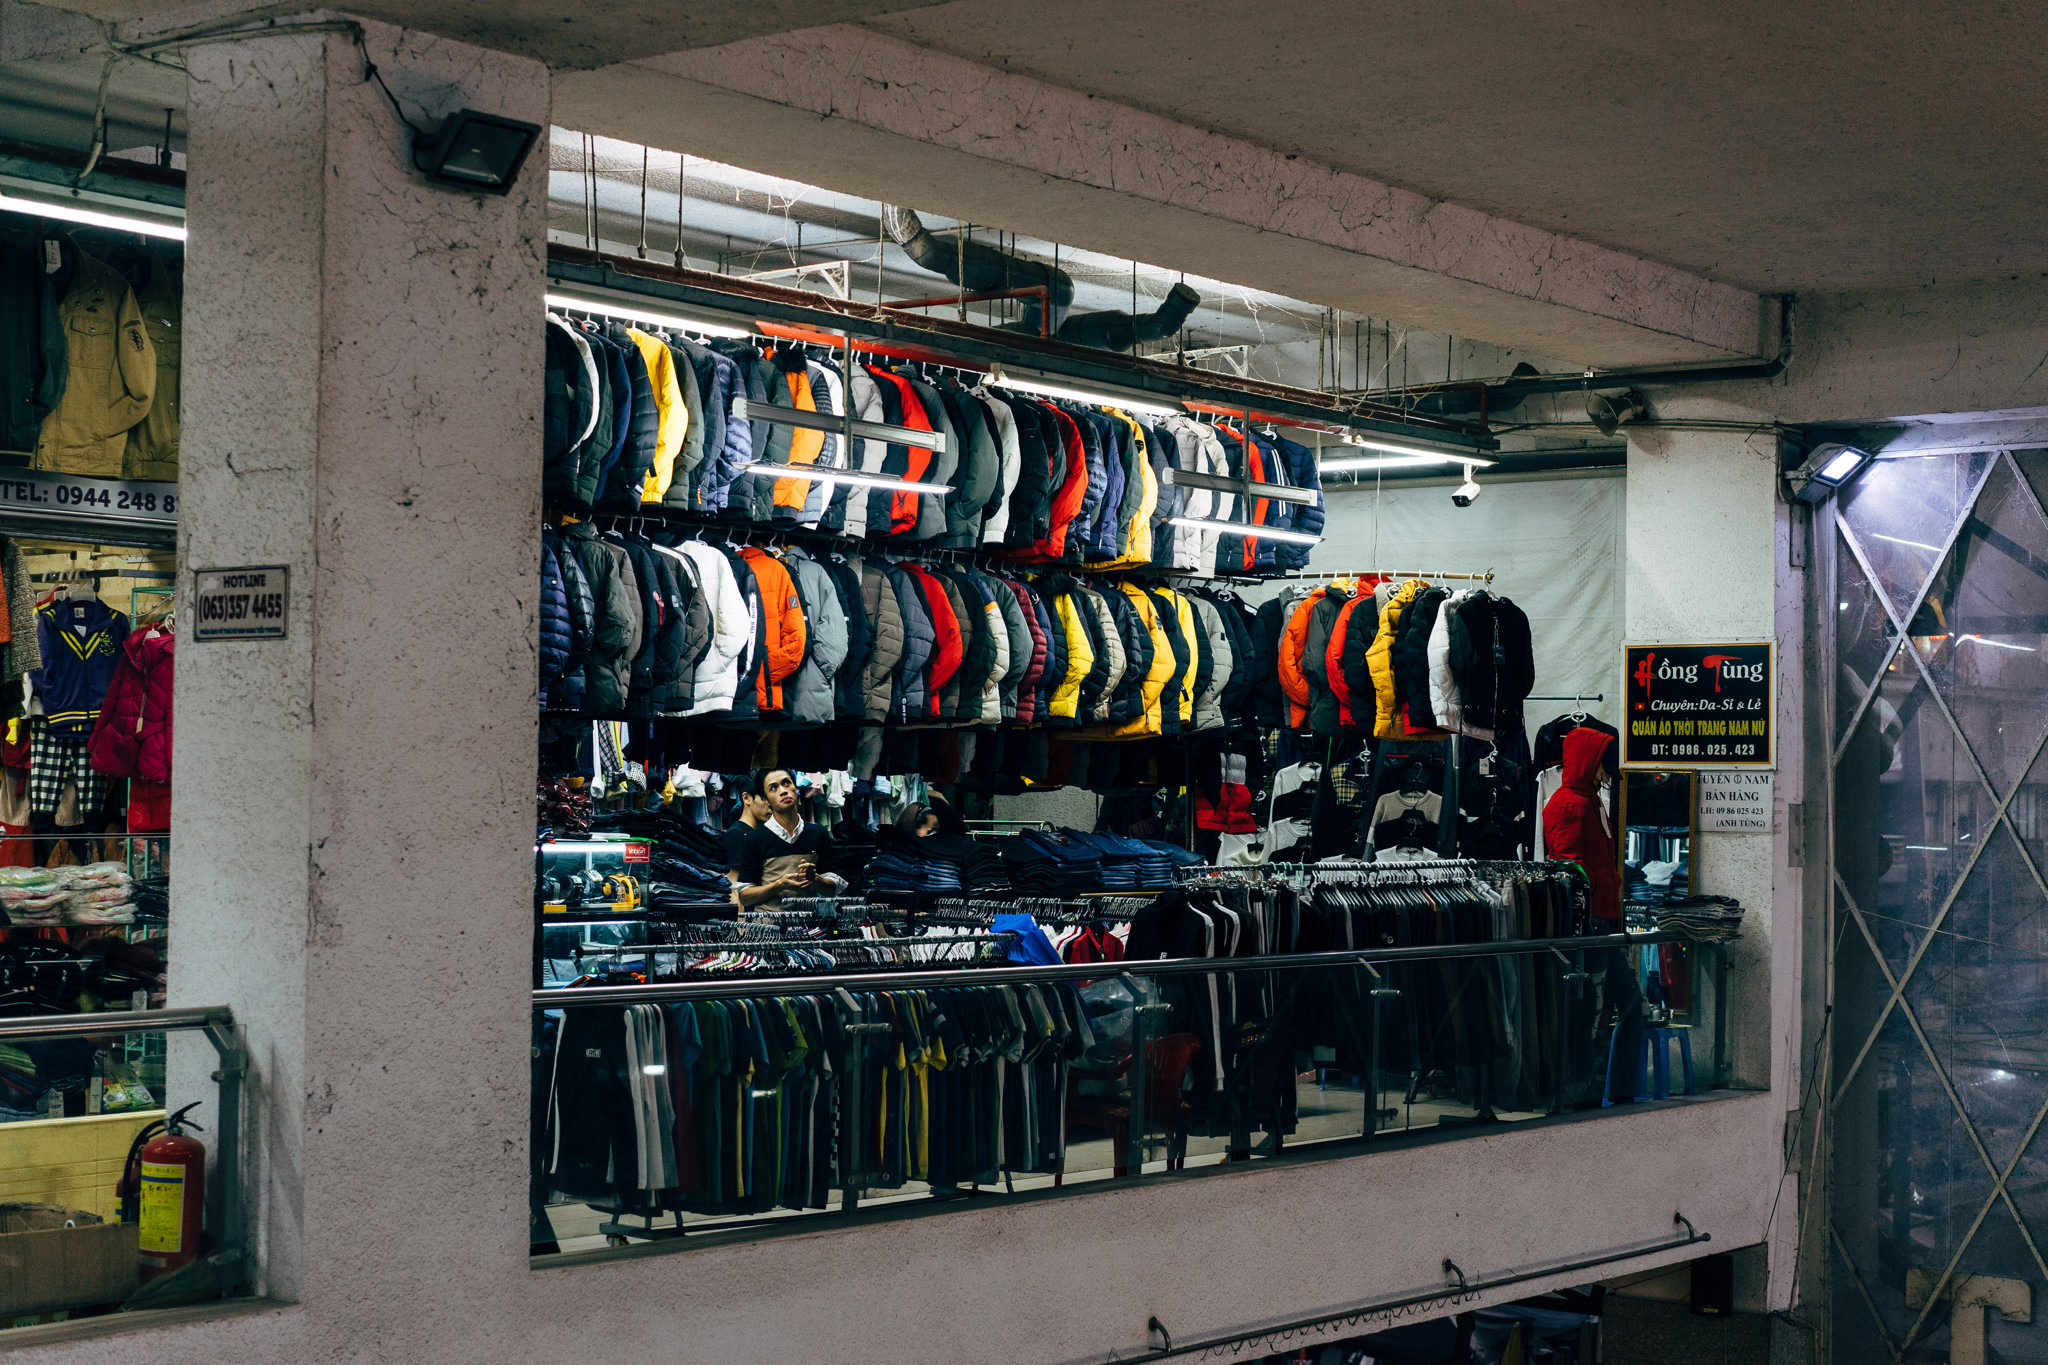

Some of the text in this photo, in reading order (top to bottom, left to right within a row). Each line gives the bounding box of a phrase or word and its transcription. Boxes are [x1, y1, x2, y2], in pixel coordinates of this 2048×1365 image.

[0, 480, 48, 502] TEL:
[56, 485, 111, 508] 0944
[117, 491, 157, 512] 248
[223, 574, 266, 588] HOTLINE
[199, 593, 282, 623] (063)357 4455
[1634, 652, 1763, 702] Hồng Tùng
[1736, 701, 1745, 711] &
[1697, 720, 1726, 736] TRANG
[1729, 720, 1749, 736] NAM
[1744, 774, 1769, 785] NAM
[1705, 788, 1759, 801] BÁN HÀNG
[1700, 807, 1715, 815] LH:
[1737, 807, 1749, 815] 025
[1751, 807, 1764, 816] 423
[1716, 819, 1737, 828] (ANH
